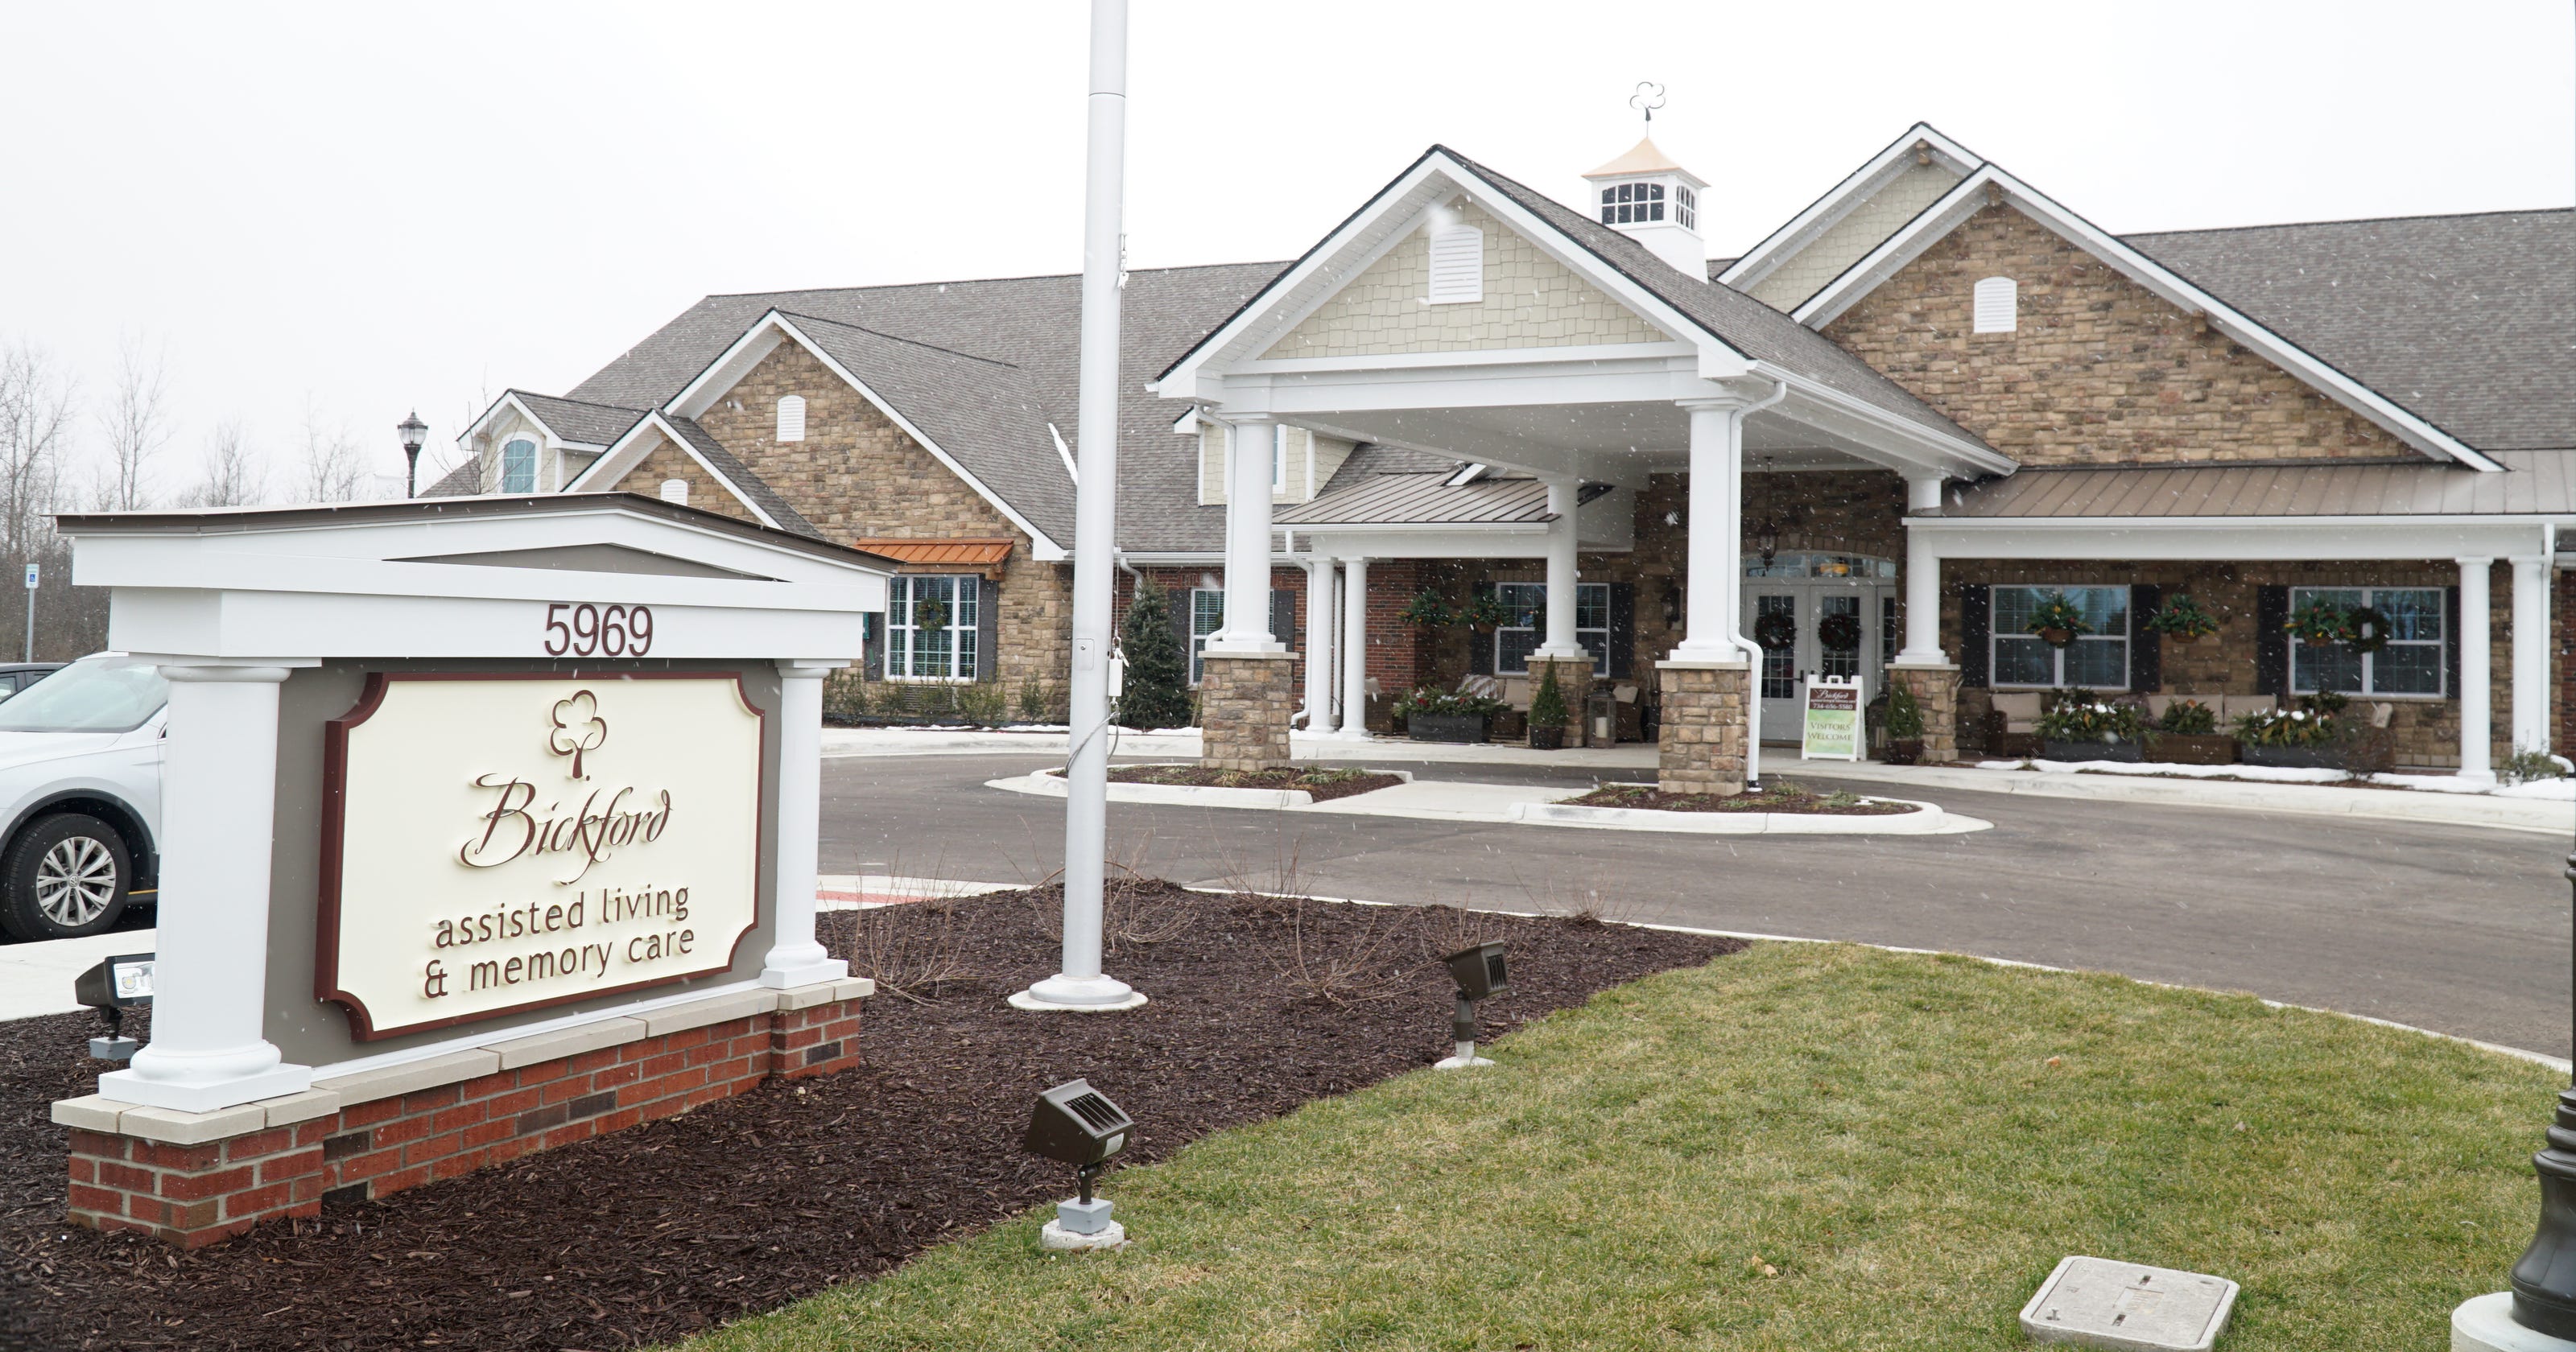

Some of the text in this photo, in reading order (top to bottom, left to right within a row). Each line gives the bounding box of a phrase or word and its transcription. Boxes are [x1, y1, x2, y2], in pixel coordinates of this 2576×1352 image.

[544, 604, 654, 657] 5969
[1808, 732, 1853, 741] WELCOME
[1810, 722, 1851, 731] VISITORS
[460, 773, 674, 886] Bickford
[435, 884, 690, 949] assisted living
[423, 928, 696, 1000] & memory care
